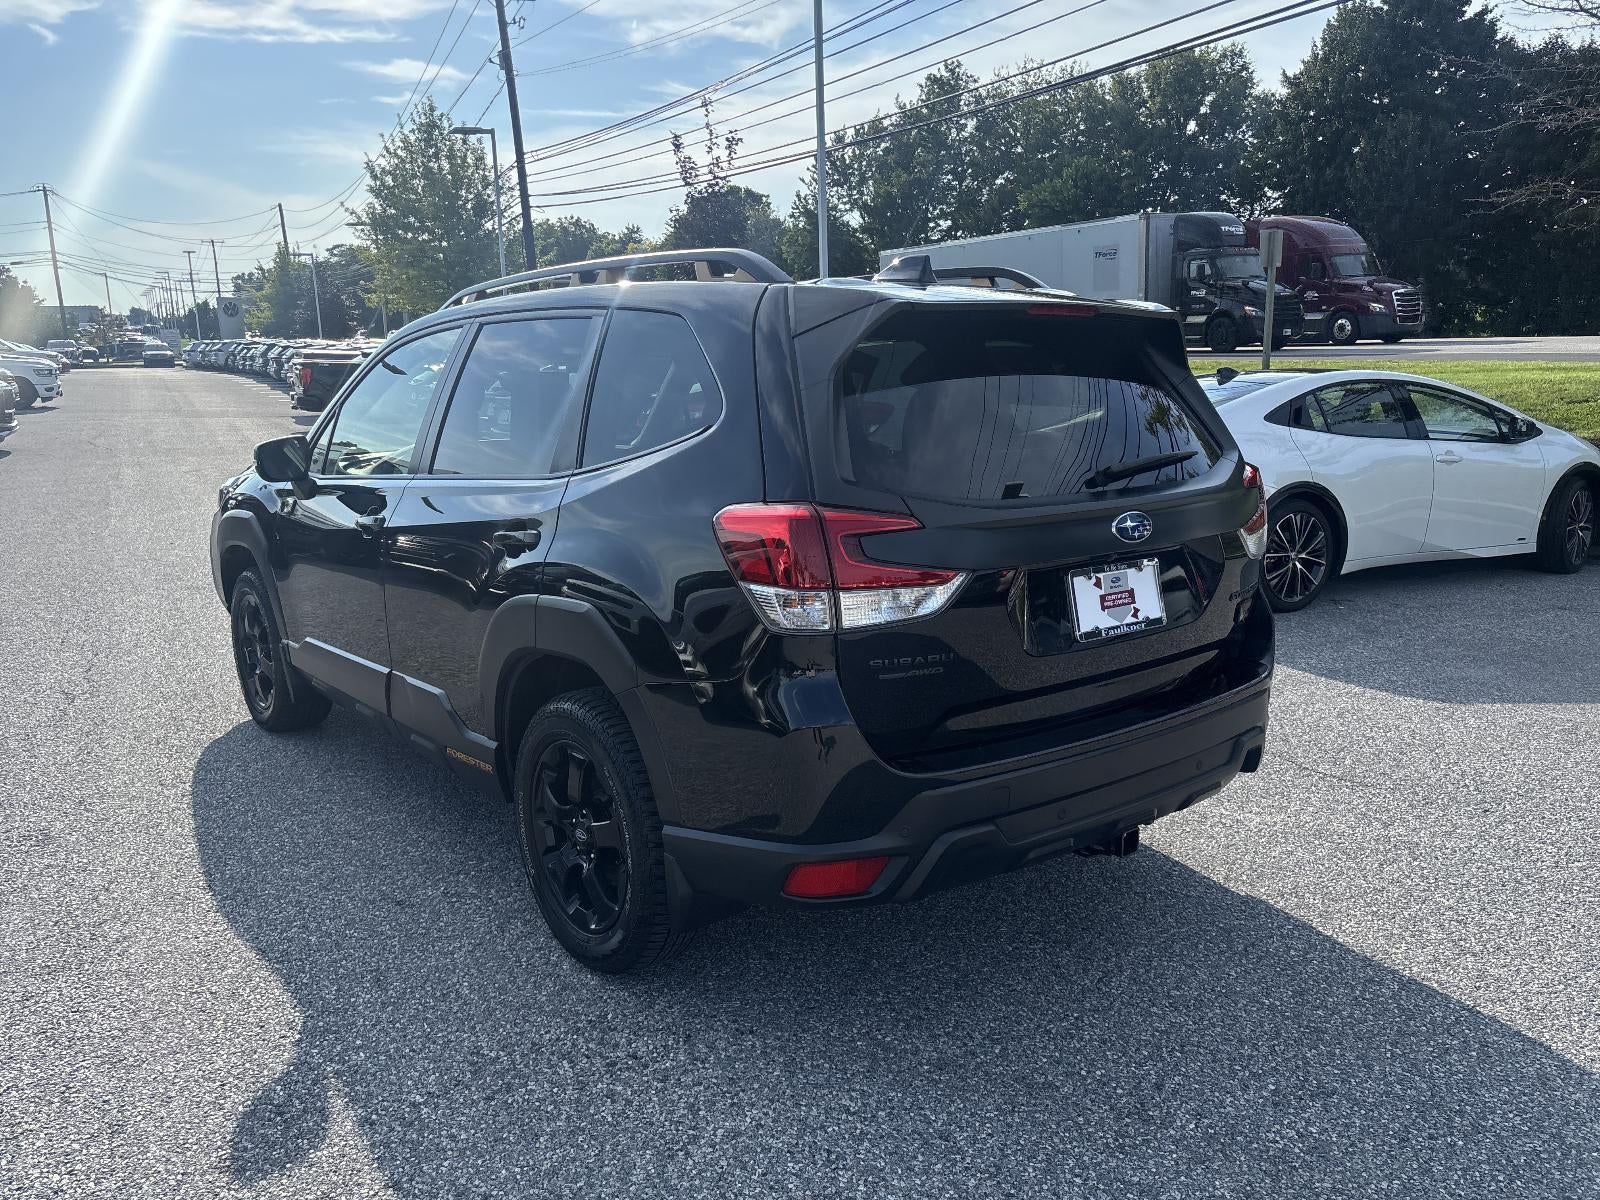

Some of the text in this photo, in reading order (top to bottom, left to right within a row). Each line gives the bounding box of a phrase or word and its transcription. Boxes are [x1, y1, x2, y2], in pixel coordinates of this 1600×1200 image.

[1094, 250, 1118, 259] TForce
[1104, 597, 1132, 606] PRE-OWNED
[1105, 592, 1129, 601] CERTIFIED
[1101, 622, 1147, 637] Faulkner
[868, 652, 954, 669] SUBARU
[905, 666, 945, 678] AWD
[446, 747, 494, 775] FORESTER
